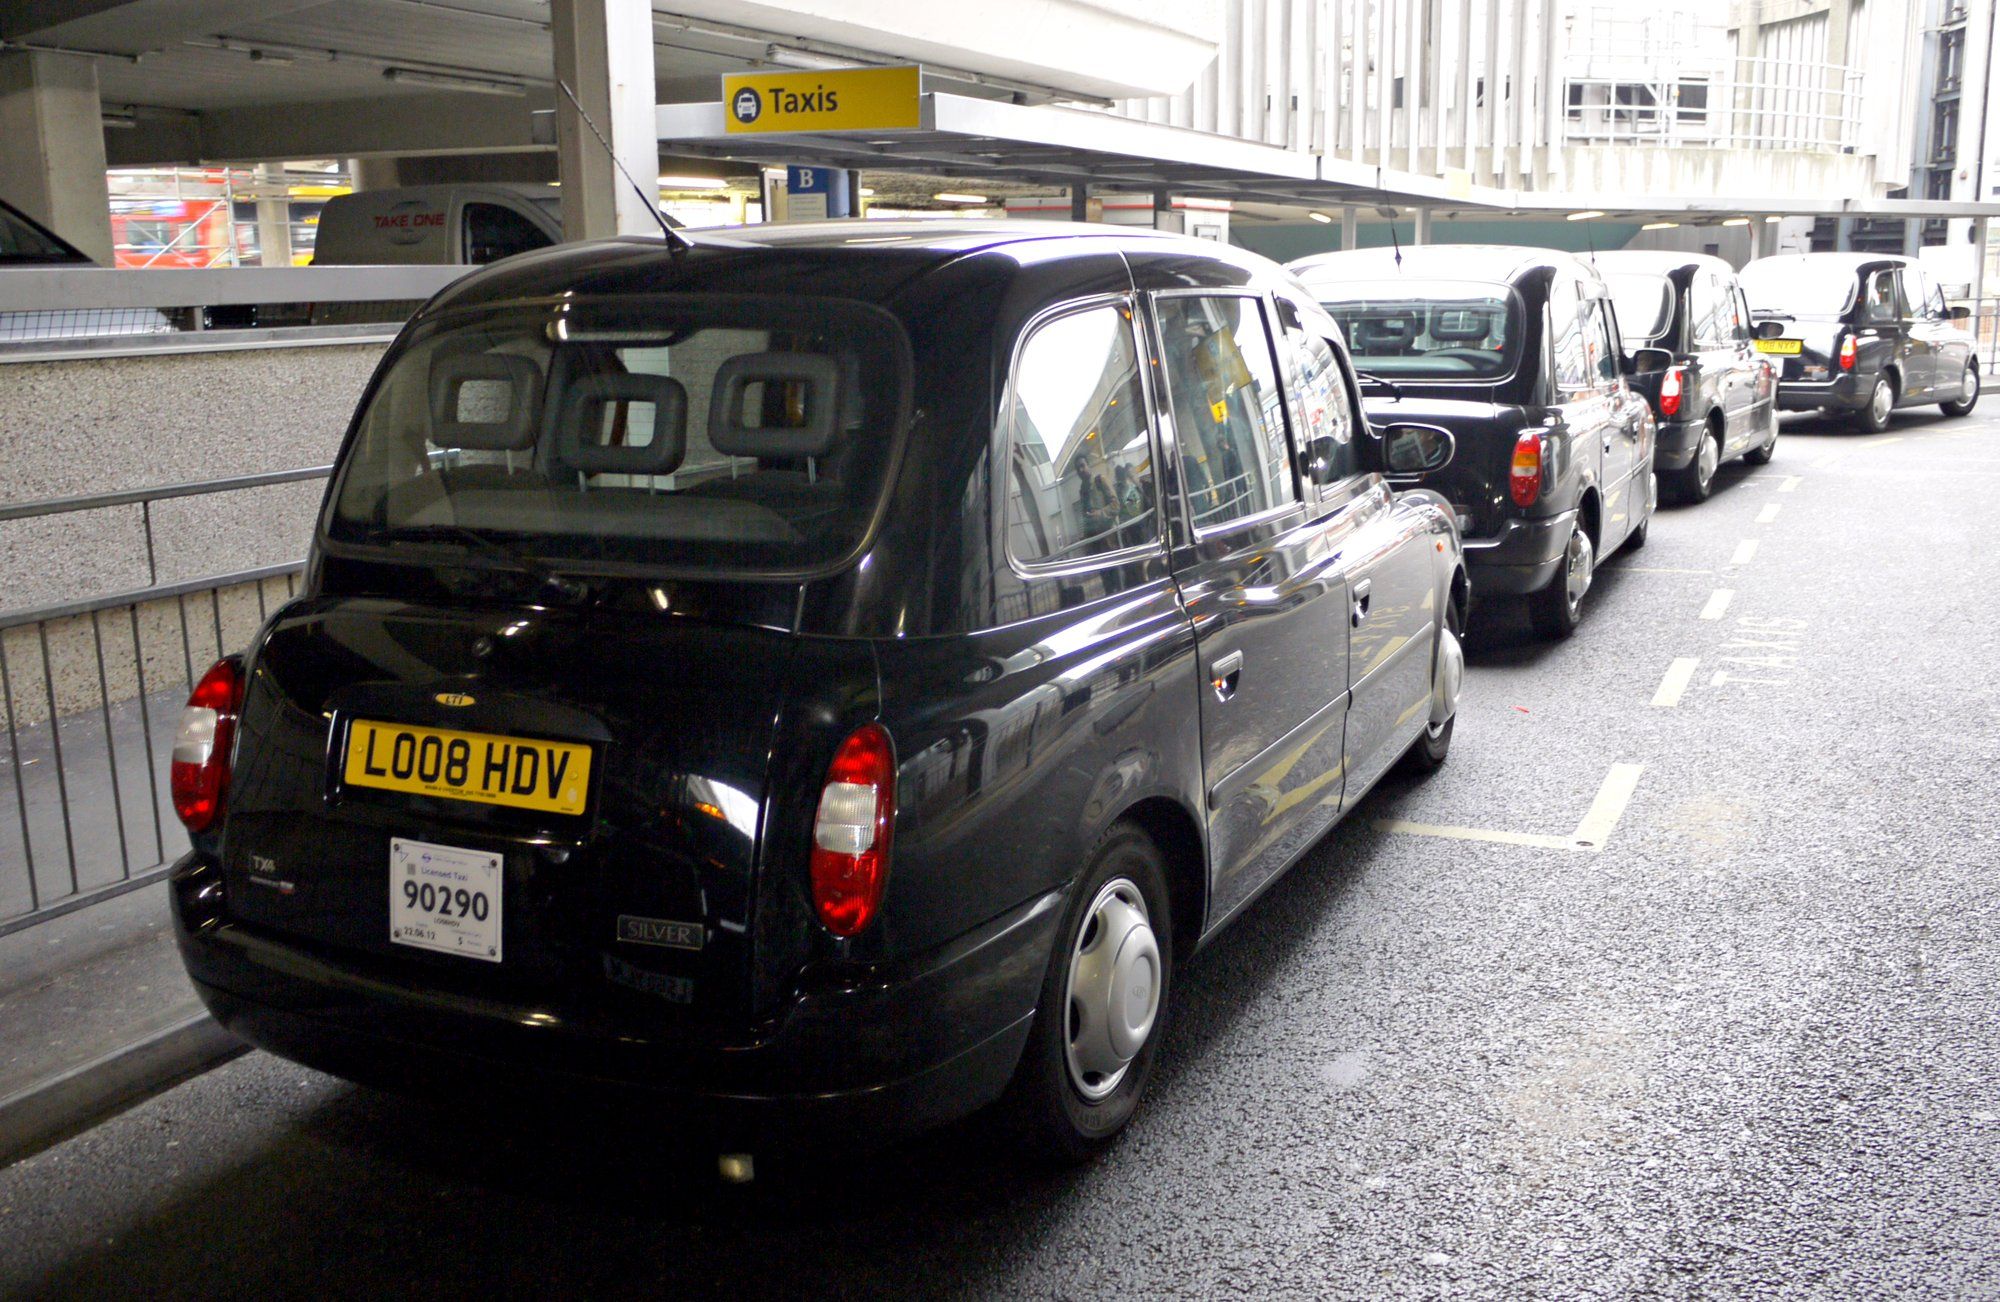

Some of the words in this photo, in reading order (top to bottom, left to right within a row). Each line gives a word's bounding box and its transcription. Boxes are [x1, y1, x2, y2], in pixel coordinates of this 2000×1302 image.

[768, 84, 838, 114] Taxis
[799, 169, 814, 188] B
[374, 214, 408, 229] TAKE
[414, 213, 445, 227] ONE
[1711, 616, 1808, 686] TAXIS
[482, 742, 571, 800] HDV
[421, 867, 452, 879] Licensed
[454, 871, 468, 881] Taxi
[403, 880, 489, 922] 90290
[627, 921, 691, 944] SILVER
